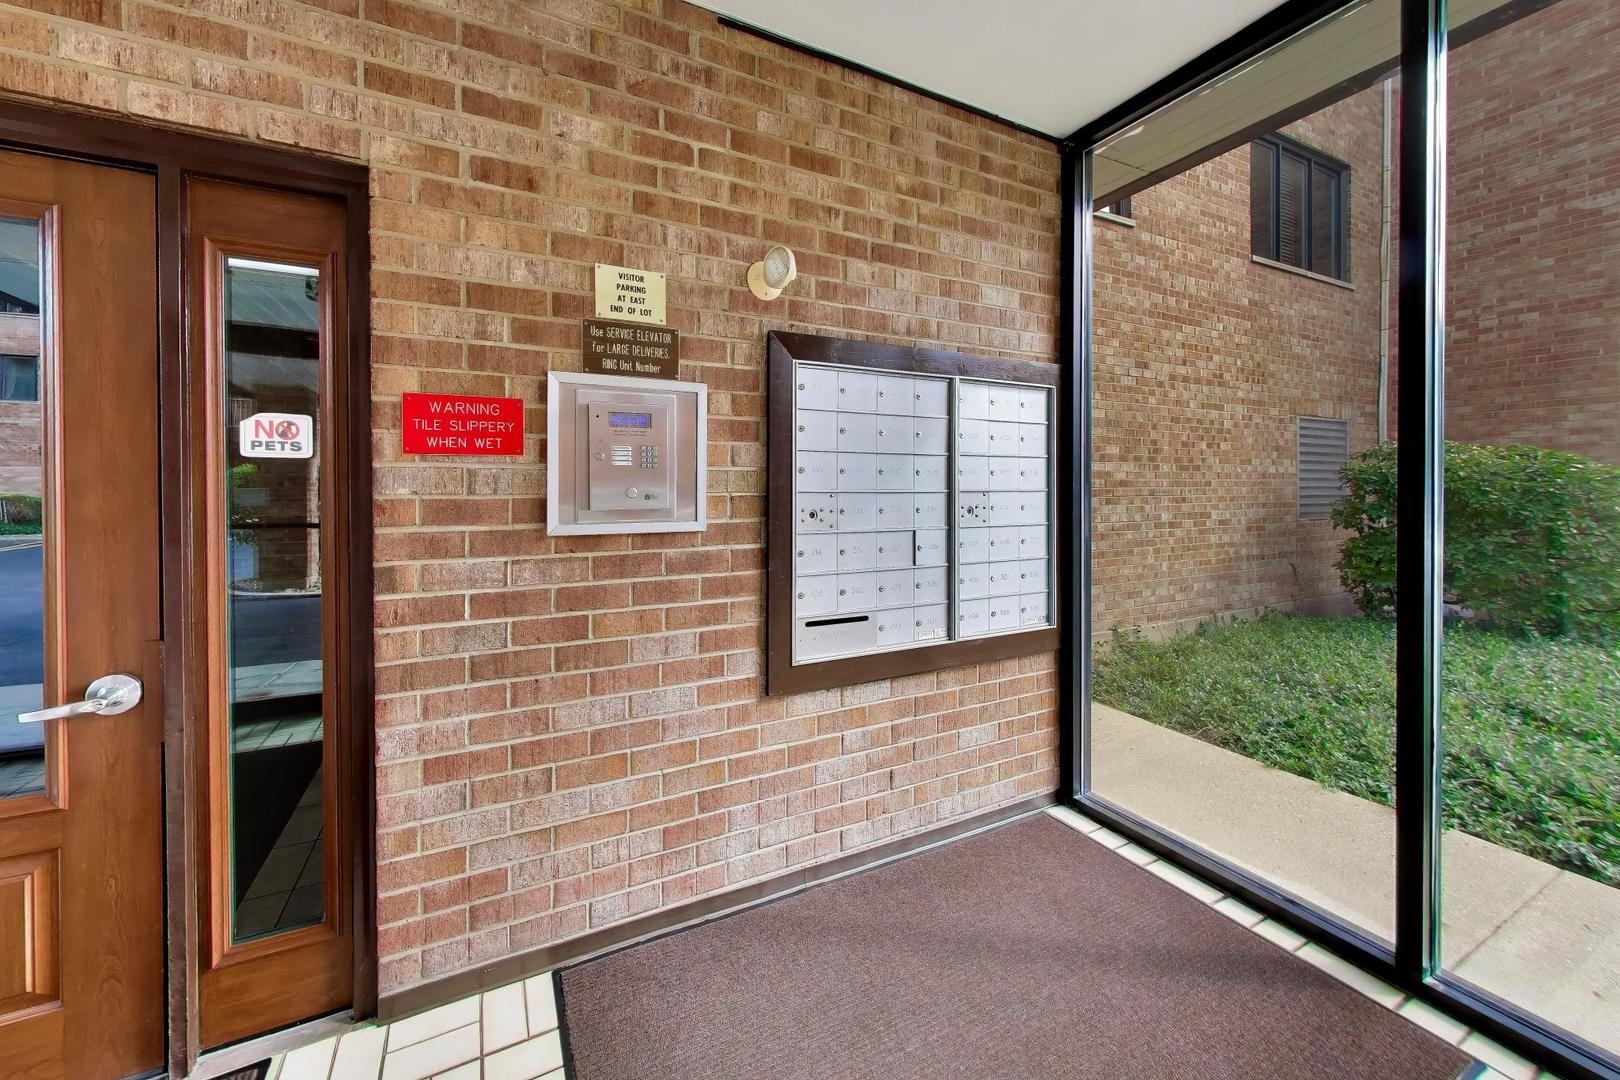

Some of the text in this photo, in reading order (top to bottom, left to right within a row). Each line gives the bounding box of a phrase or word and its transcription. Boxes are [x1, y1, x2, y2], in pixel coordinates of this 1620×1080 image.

[618, 272, 645, 283] VISITOR
[616, 283, 646, 294] PARKING
[630, 296, 646, 305] EAST
[610, 305, 652, 317] END OF LOT
[590, 325, 672, 344] Use SERVICE ELEVATOR
[607, 343, 629, 355] LARGE
[602, 358, 661, 374] RING Unit Number
[429, 401, 500, 416] WARNING
[412, 418, 515, 433] TILE SLIPPERY
[250, 440, 303, 452] PETS
[426, 436, 503, 449] WHEN WET
